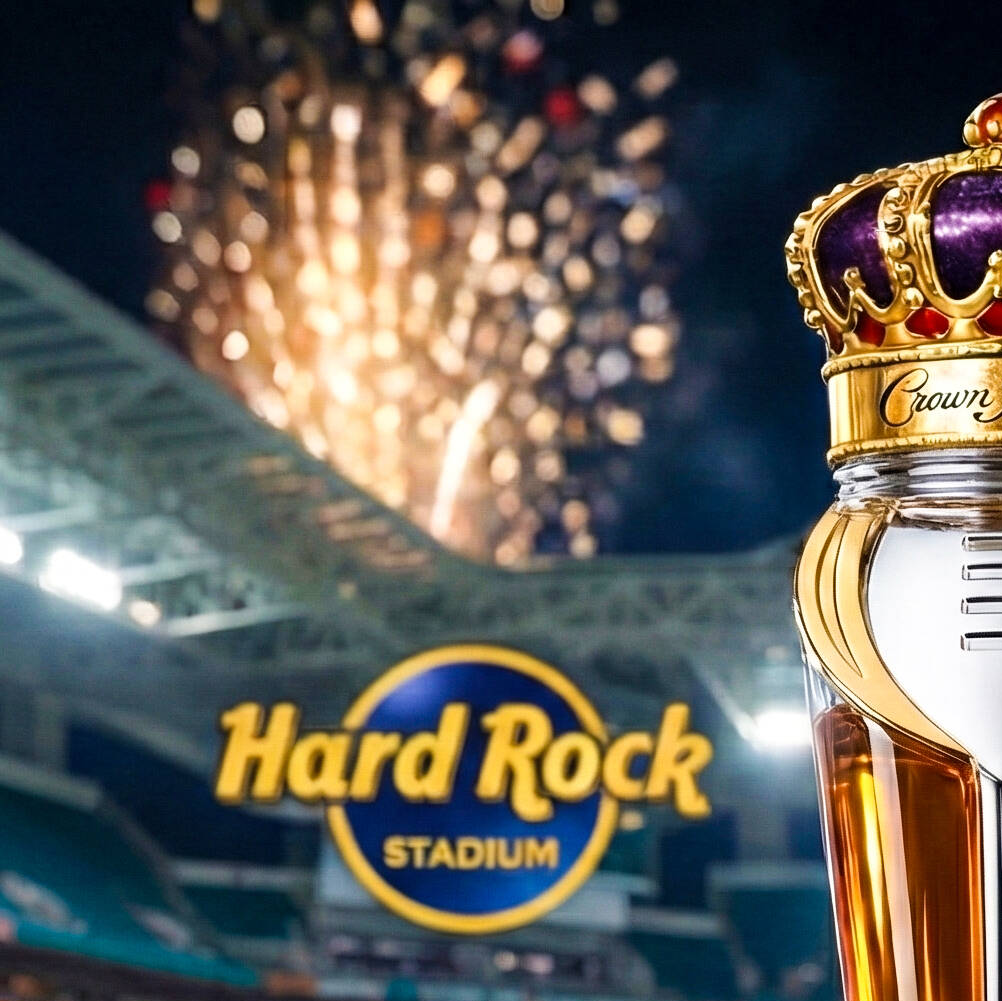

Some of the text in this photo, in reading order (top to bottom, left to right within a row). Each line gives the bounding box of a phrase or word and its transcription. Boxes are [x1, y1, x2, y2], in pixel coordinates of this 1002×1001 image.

[880, 367, 993, 427] Crown
[215, 702, 713, 822] Hard Rock
[383, 836, 559, 870] STADIUM
